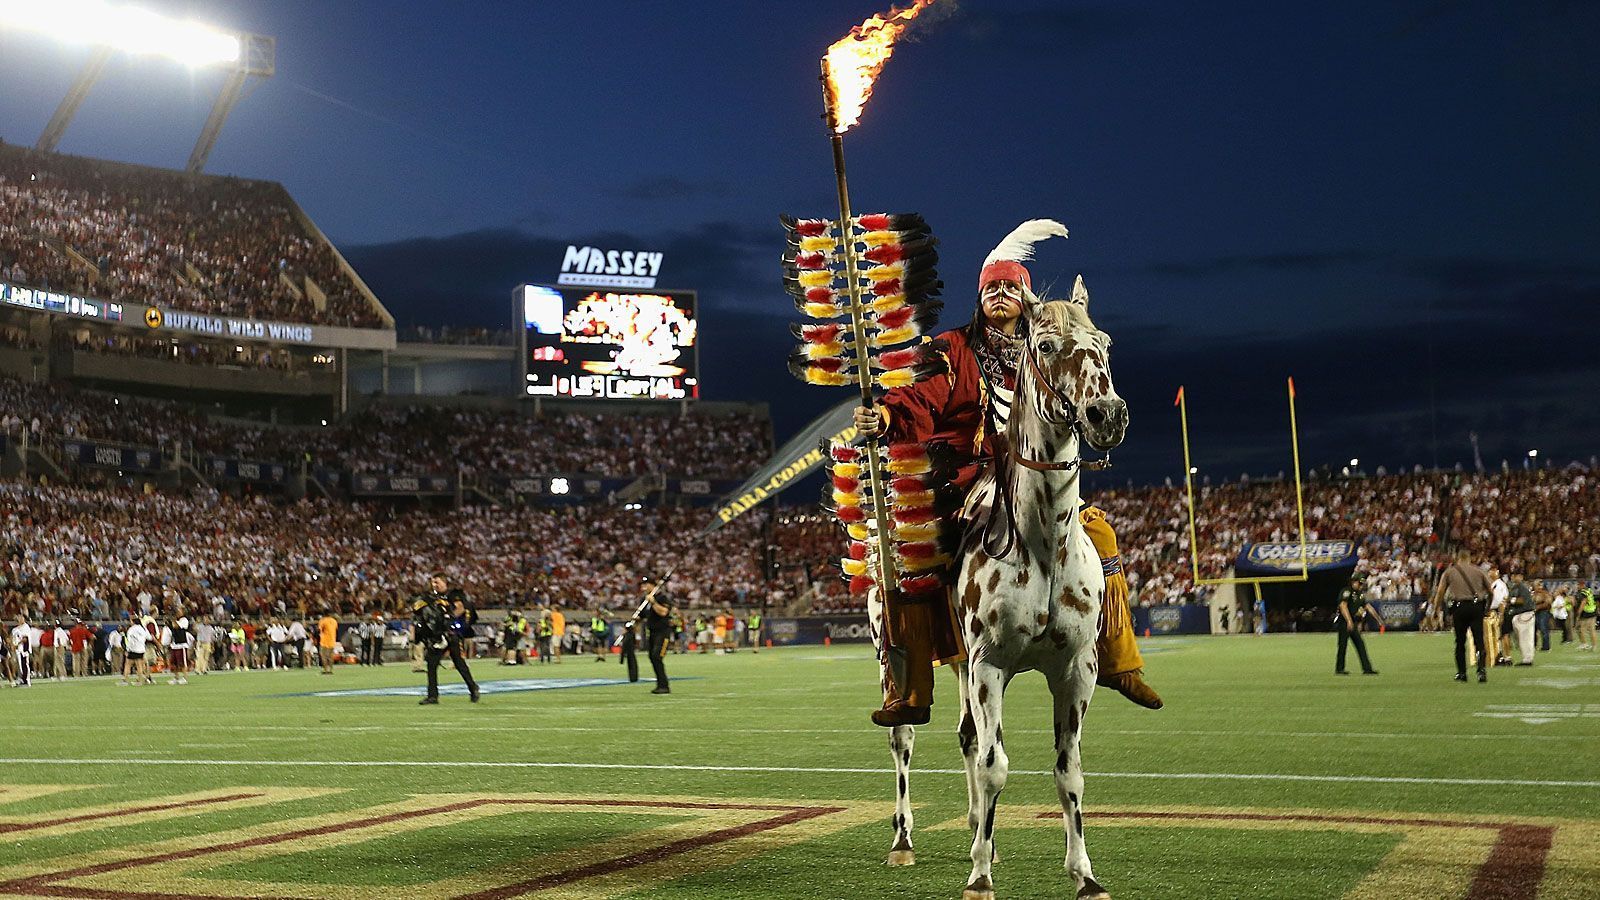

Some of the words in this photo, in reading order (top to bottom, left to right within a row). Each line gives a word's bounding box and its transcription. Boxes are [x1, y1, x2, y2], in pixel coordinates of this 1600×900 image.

[561, 244, 664, 277] MASSEY
[163, 311, 223, 334] BUFFALO
[228, 319, 264, 338] WILD
[268, 323, 312, 342] WINGS
